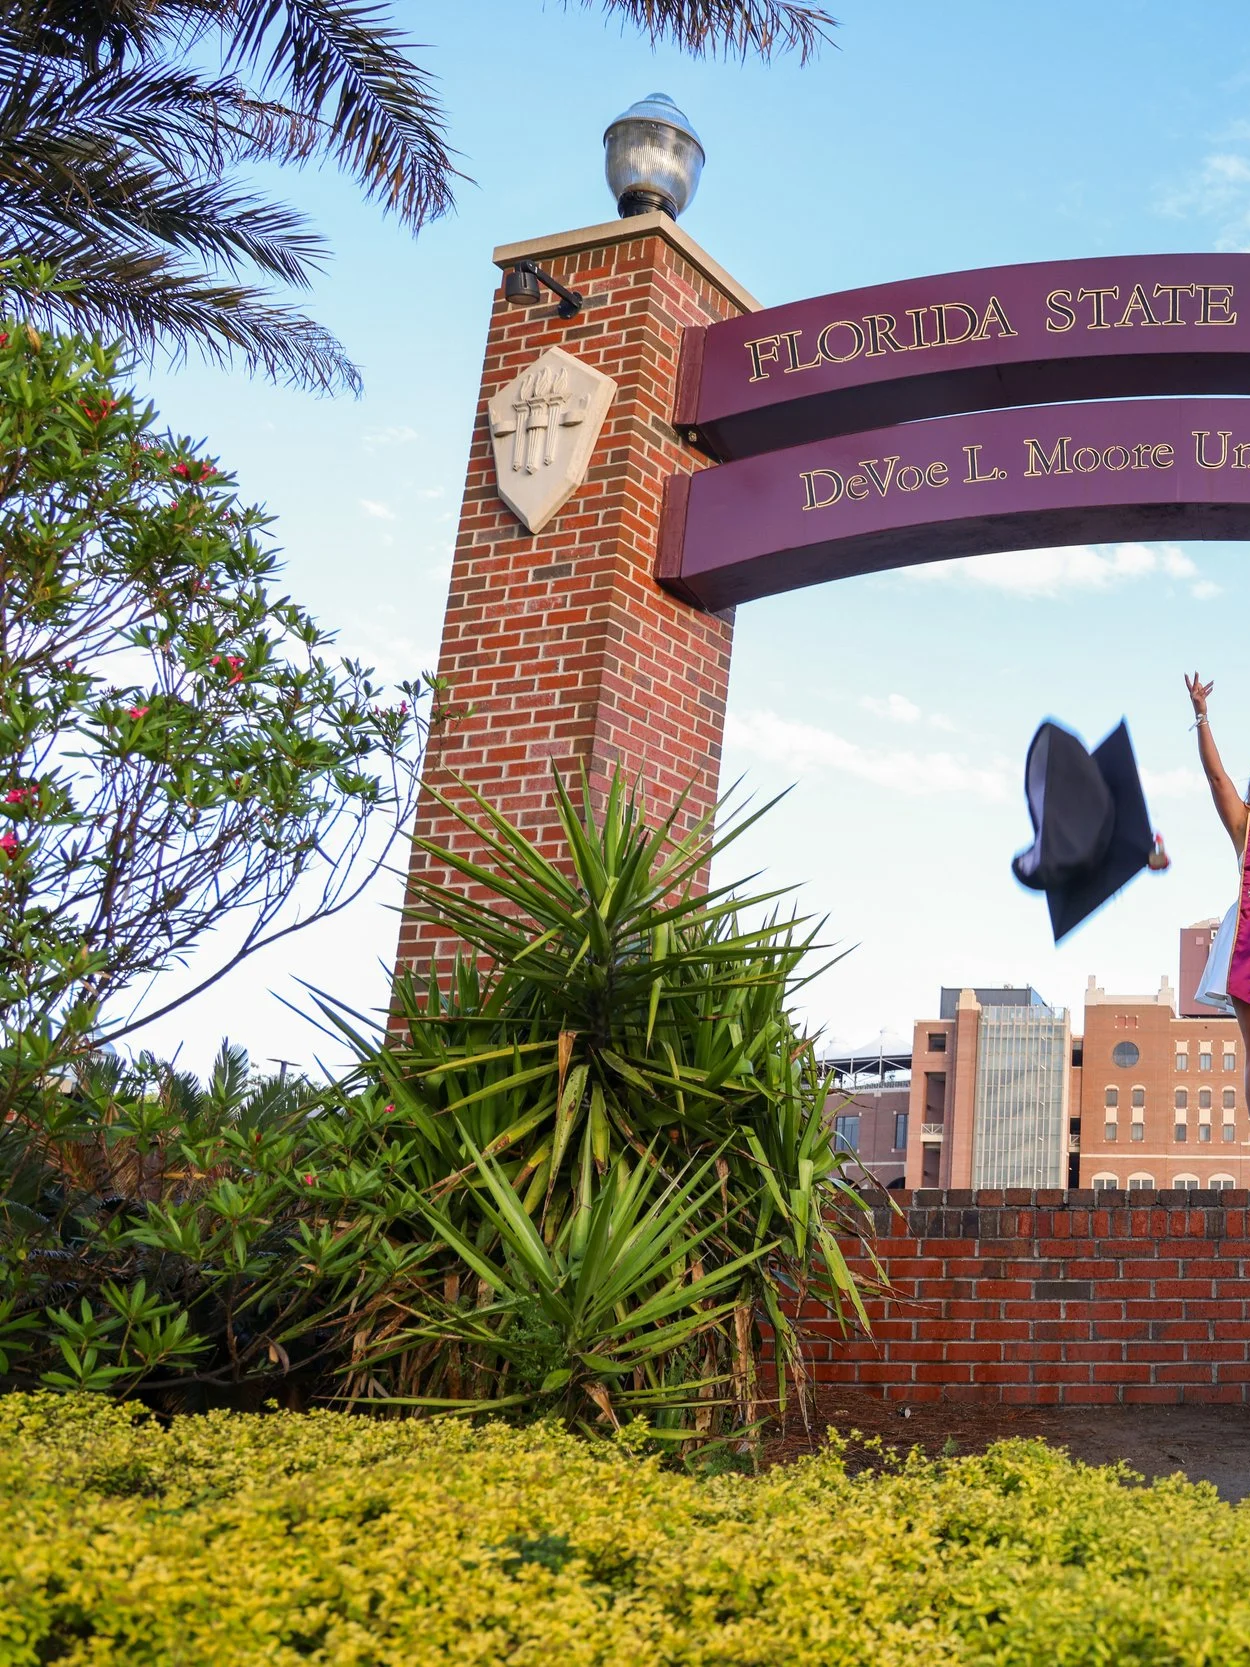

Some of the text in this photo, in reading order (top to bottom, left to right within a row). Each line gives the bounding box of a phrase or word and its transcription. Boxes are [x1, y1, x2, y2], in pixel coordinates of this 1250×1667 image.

[745, 296, 1018, 382] FLORIDA
[1046, 283, 1237, 332] STATE
[799, 456, 949, 511] DeVoe
[962, 445, 1008, 483] L.
[1023, 436, 1175, 476] Moore
